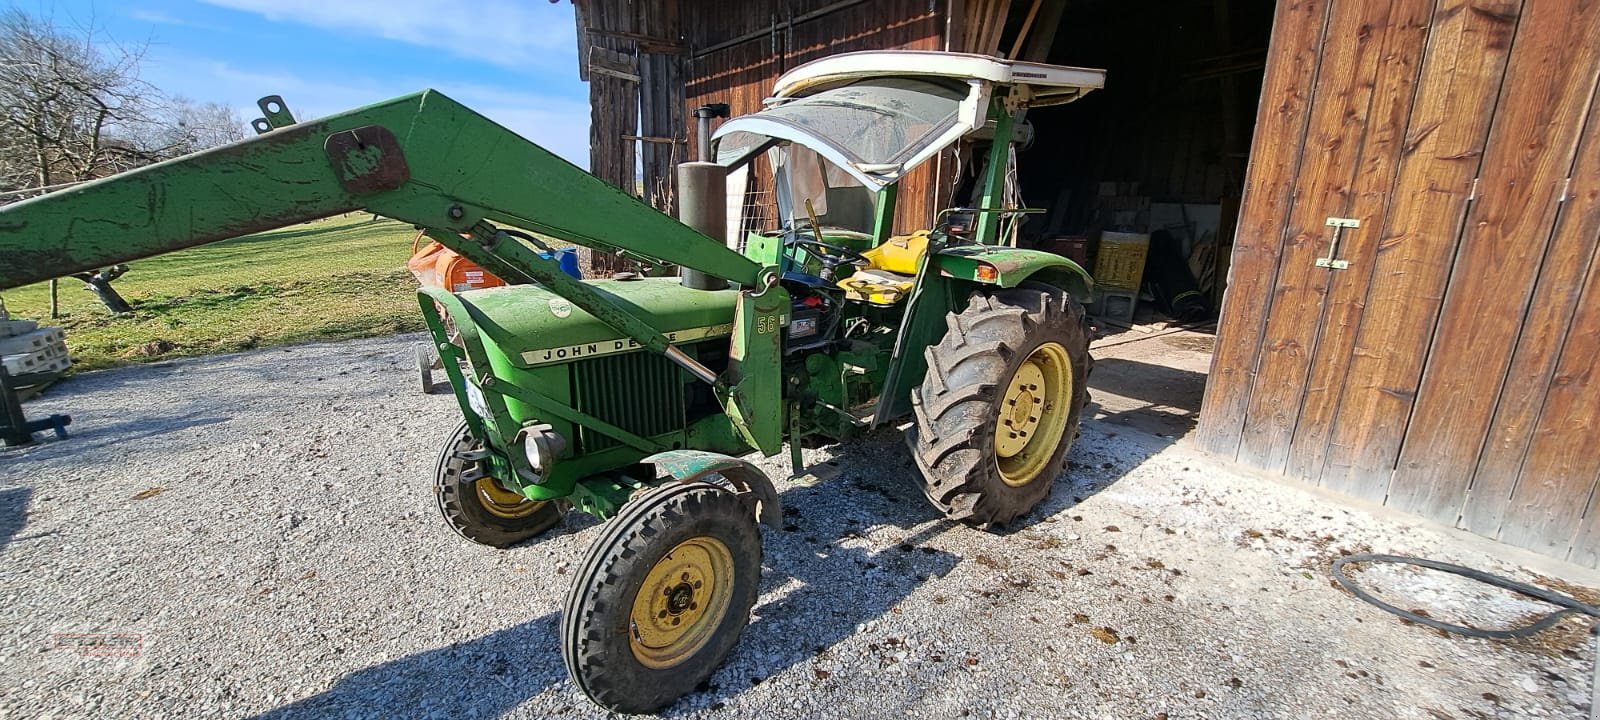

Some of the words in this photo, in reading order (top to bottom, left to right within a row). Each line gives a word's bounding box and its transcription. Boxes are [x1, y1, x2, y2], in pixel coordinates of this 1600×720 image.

[757, 315, 776, 334] 56
[543, 344, 597, 360] JOHN
[614, 333, 677, 350] DEE
